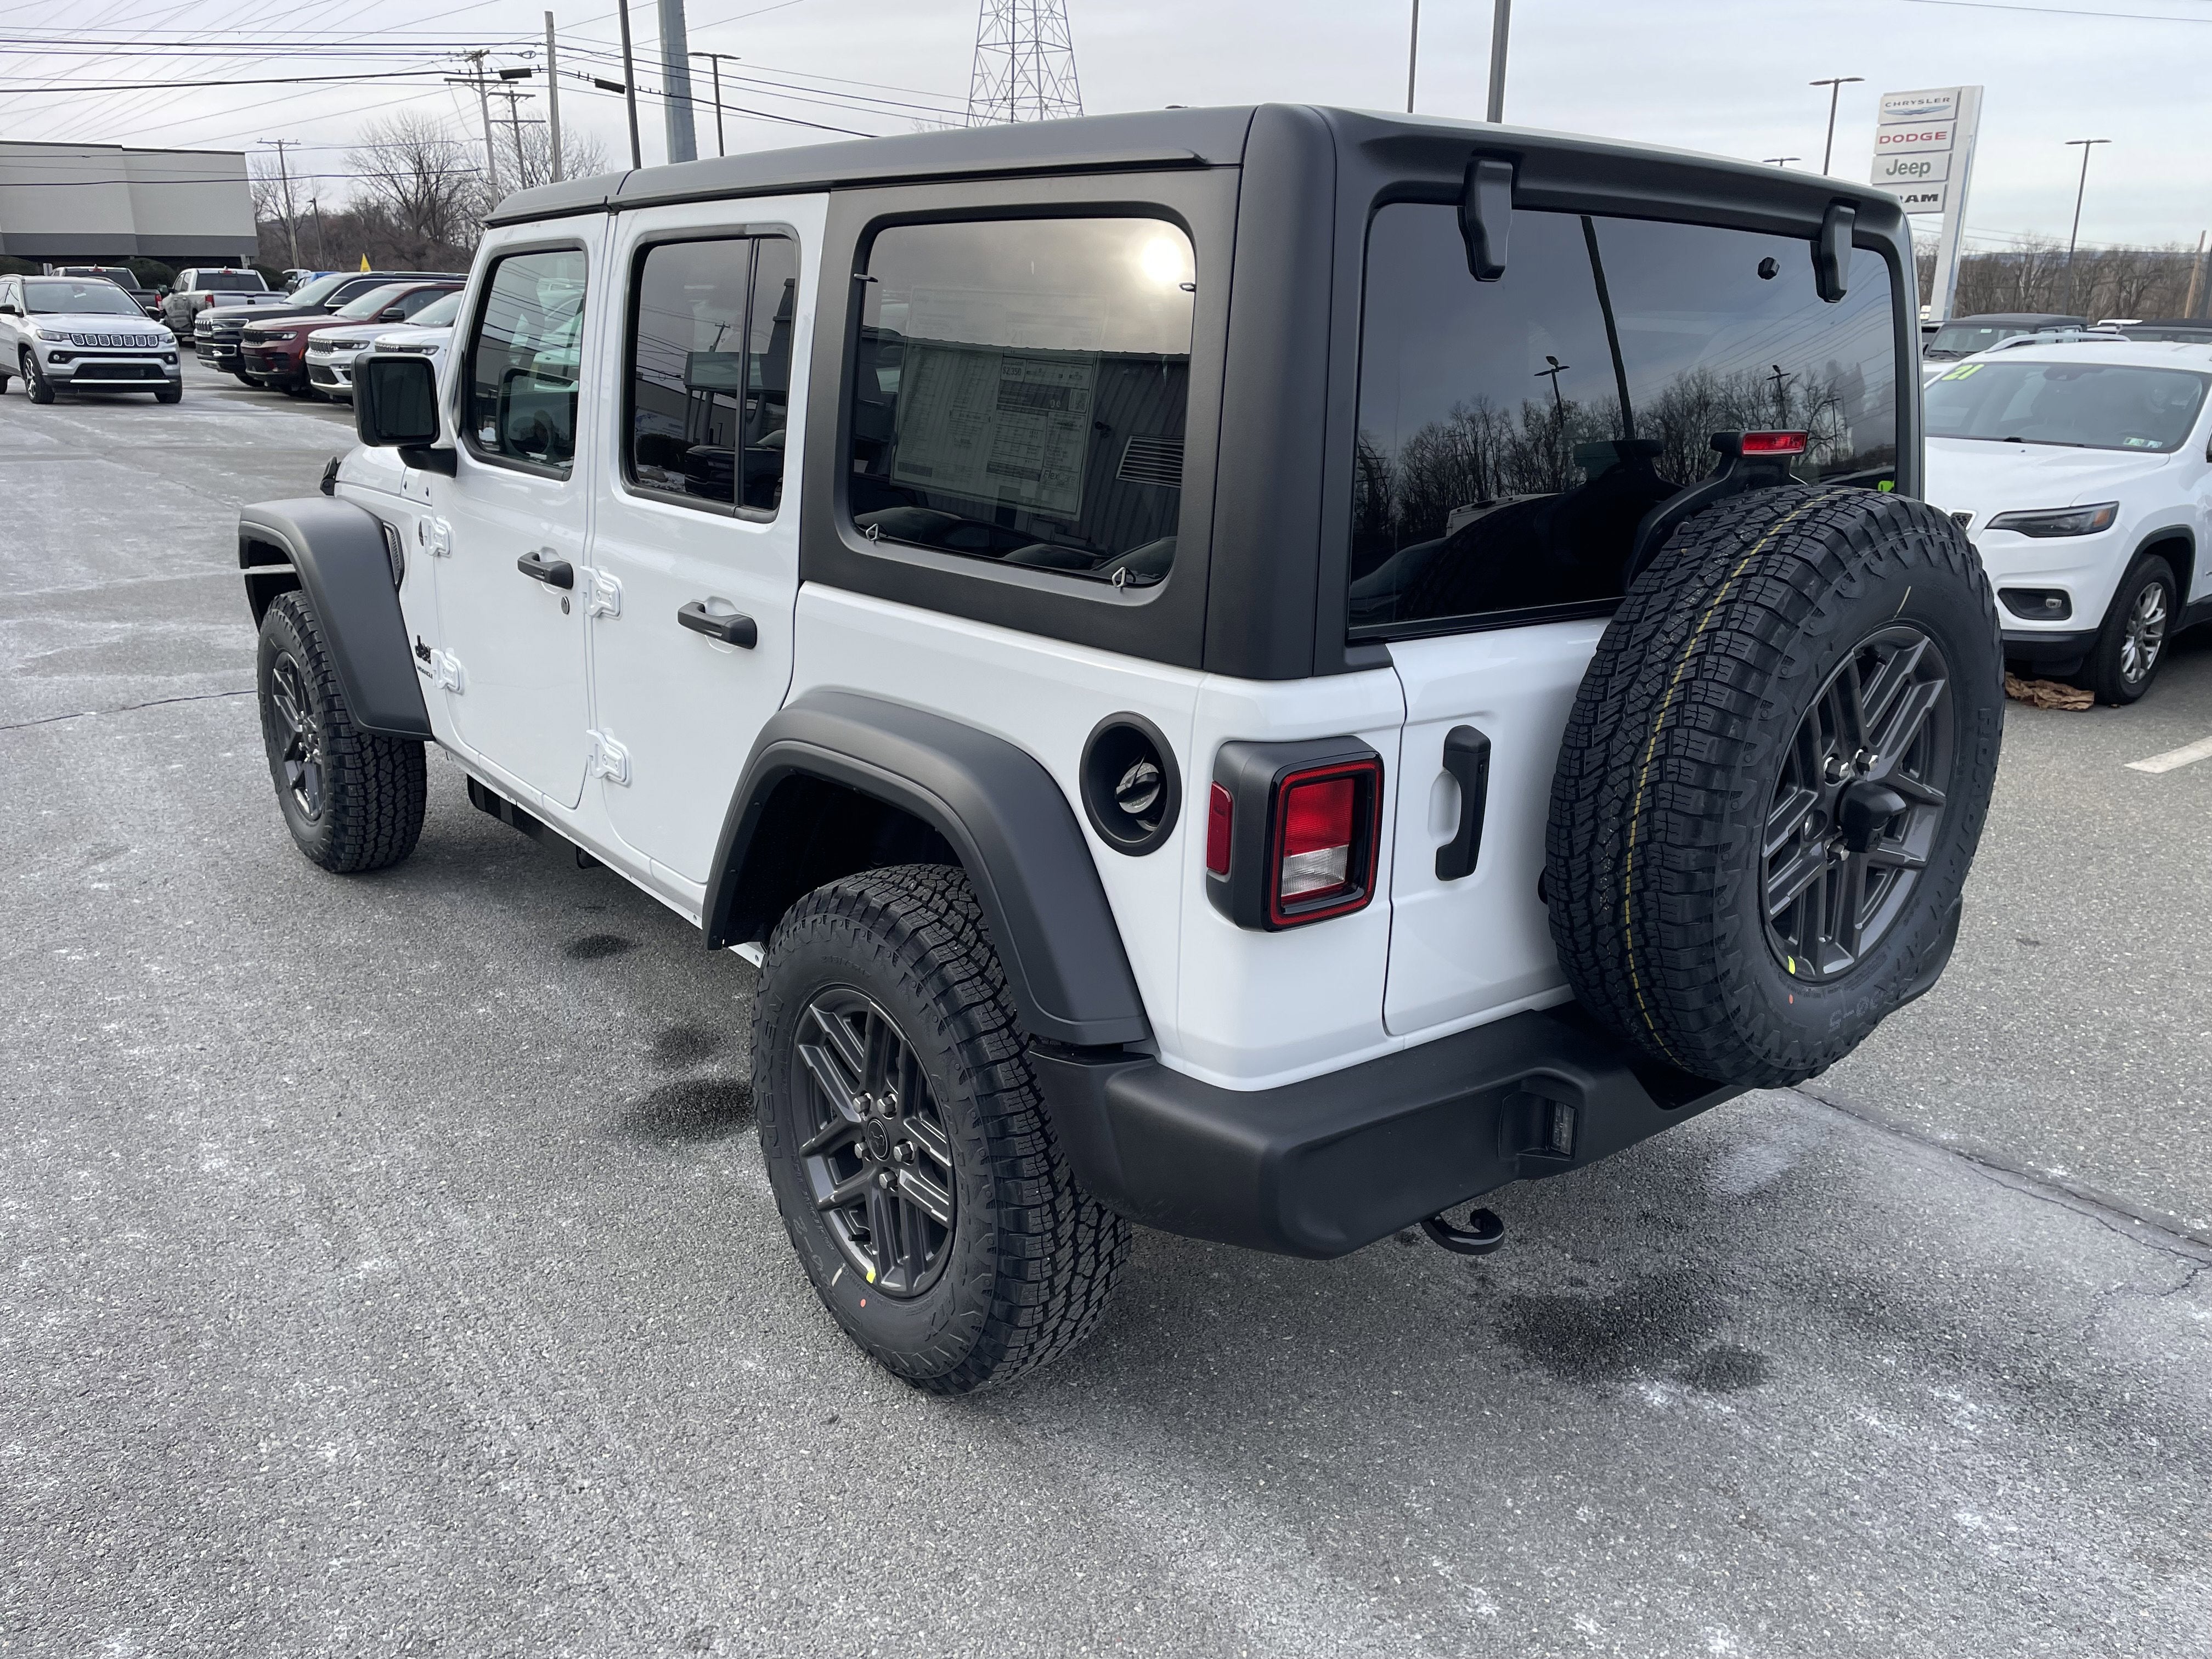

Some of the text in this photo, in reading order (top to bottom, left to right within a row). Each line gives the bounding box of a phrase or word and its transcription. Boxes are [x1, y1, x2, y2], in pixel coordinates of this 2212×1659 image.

[1885, 97, 1950, 108] CHRYSLER
[1878, 131, 1948, 144] DODGE
[1886, 159, 1931, 178] Jeep
[1899, 193, 1939, 204] AM
[1941, 363, 1985, 381] 21
[760, 992, 784, 1159] NEXEN
